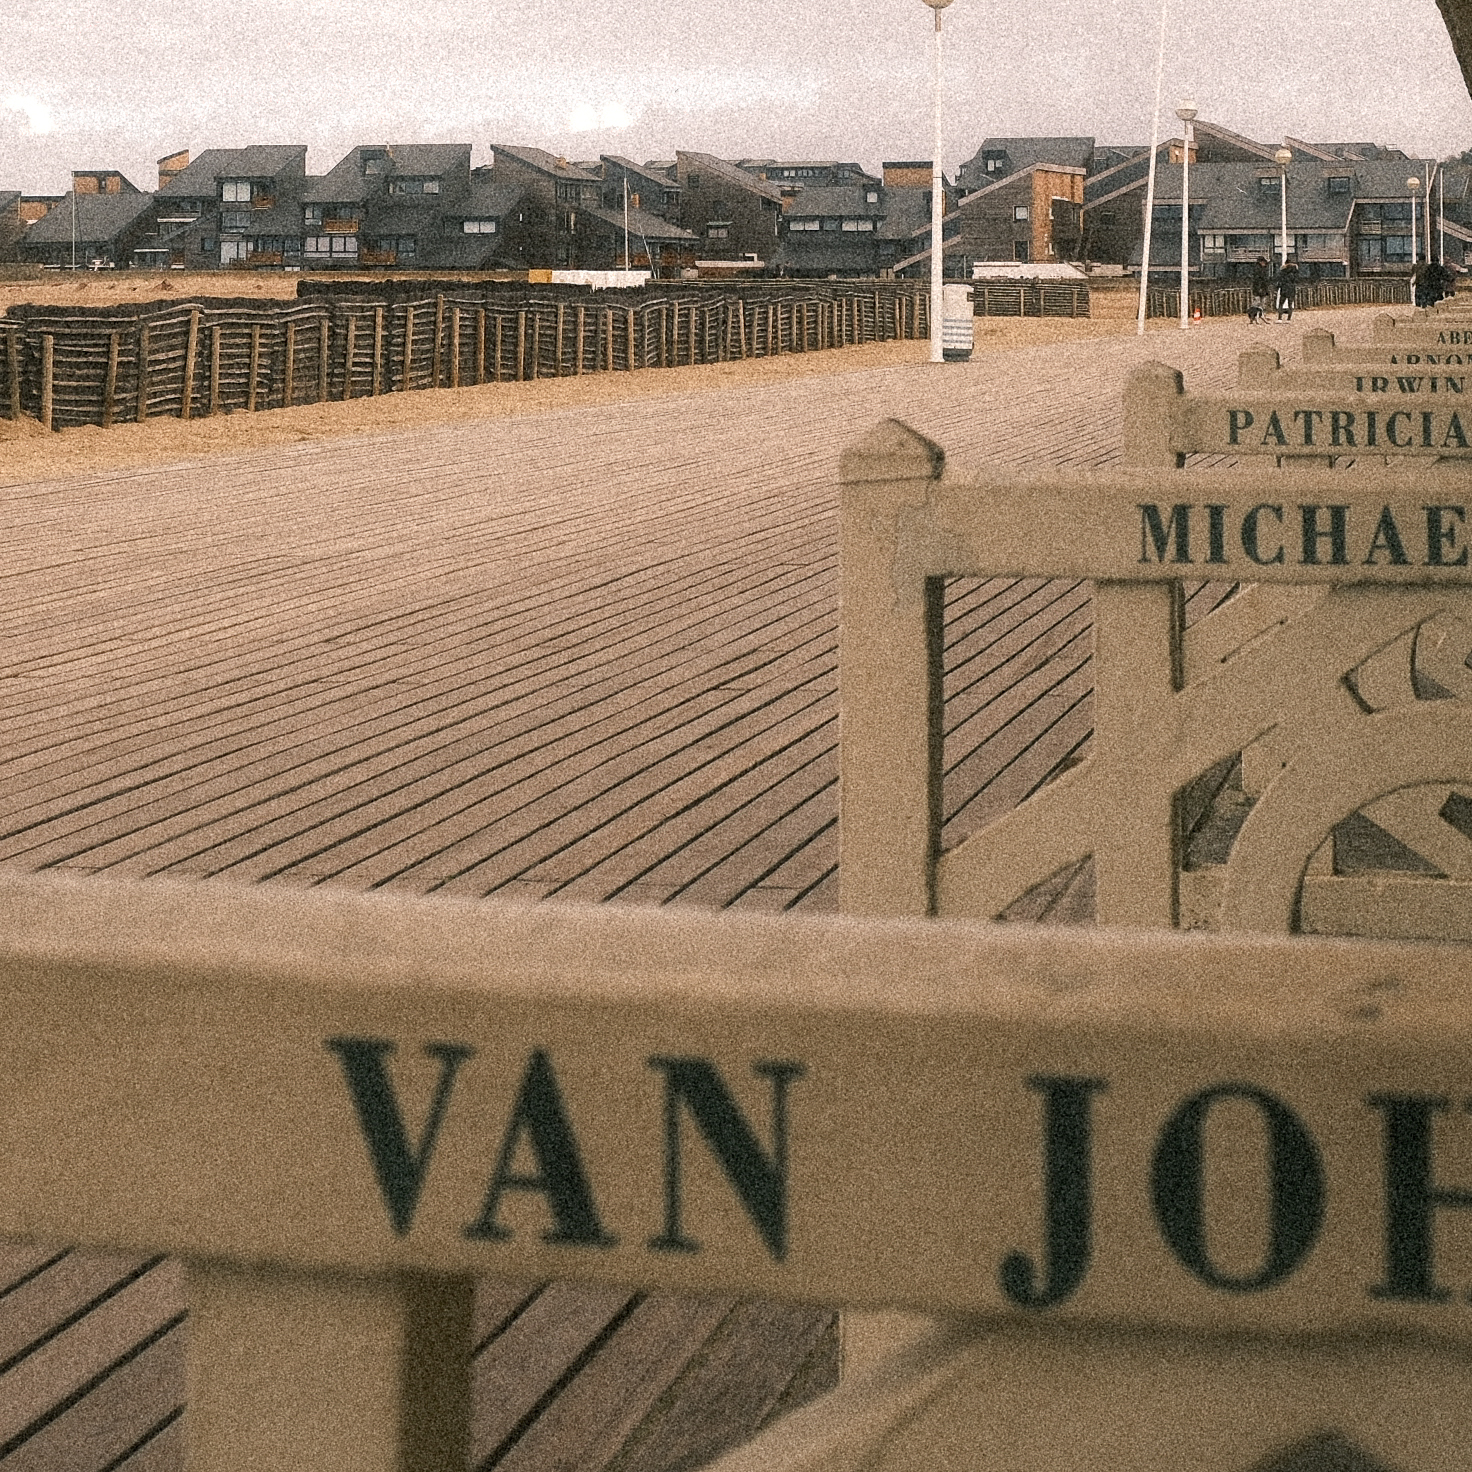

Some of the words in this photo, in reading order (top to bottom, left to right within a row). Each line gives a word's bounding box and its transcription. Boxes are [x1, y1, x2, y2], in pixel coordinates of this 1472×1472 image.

[1355, 376, 1466, 394] IRWIN
[1227, 409, 1471, 449] PATRICIA
[326, 1036, 807, 1263] VAN
